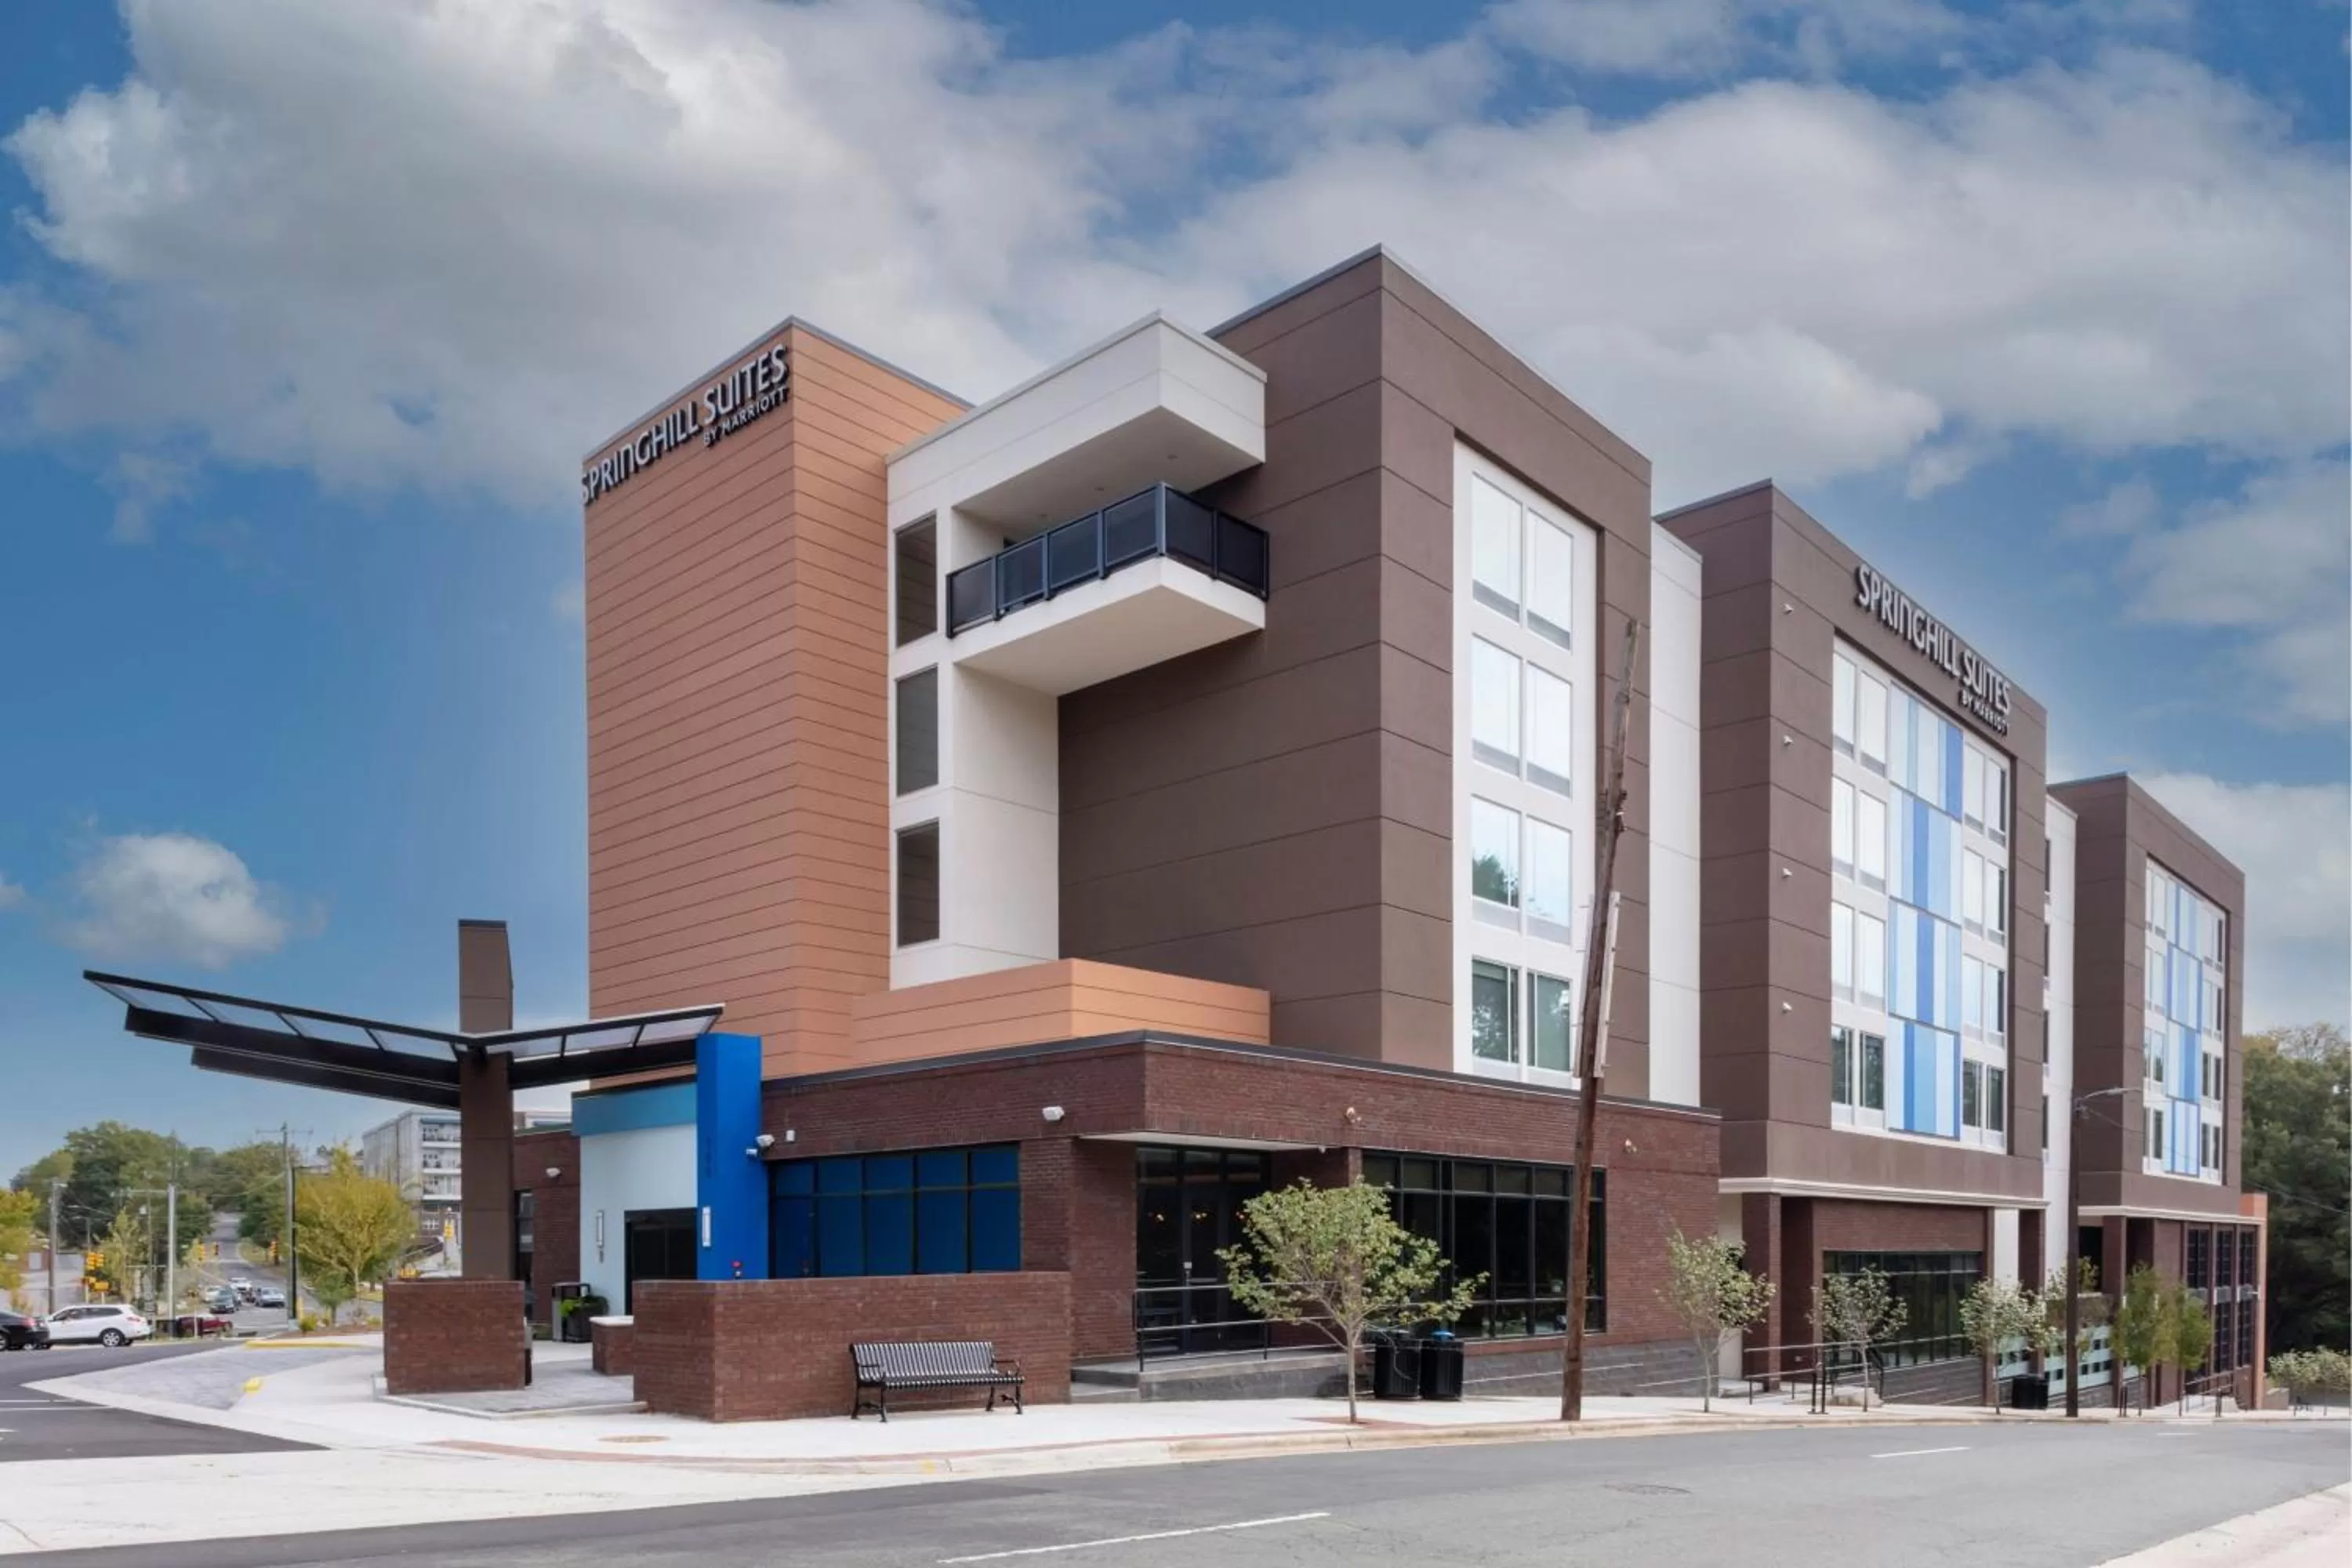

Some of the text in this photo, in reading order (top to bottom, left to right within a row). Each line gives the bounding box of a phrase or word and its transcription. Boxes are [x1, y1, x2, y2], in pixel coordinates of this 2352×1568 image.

[581, 343, 788, 505] SPRINGHILL SUITES
[702, 388, 788, 446] BY MARRIOTT
[1857, 564, 2011, 715] SPRINGHILL SUITES
[1962, 689, 1973, 706] BY
